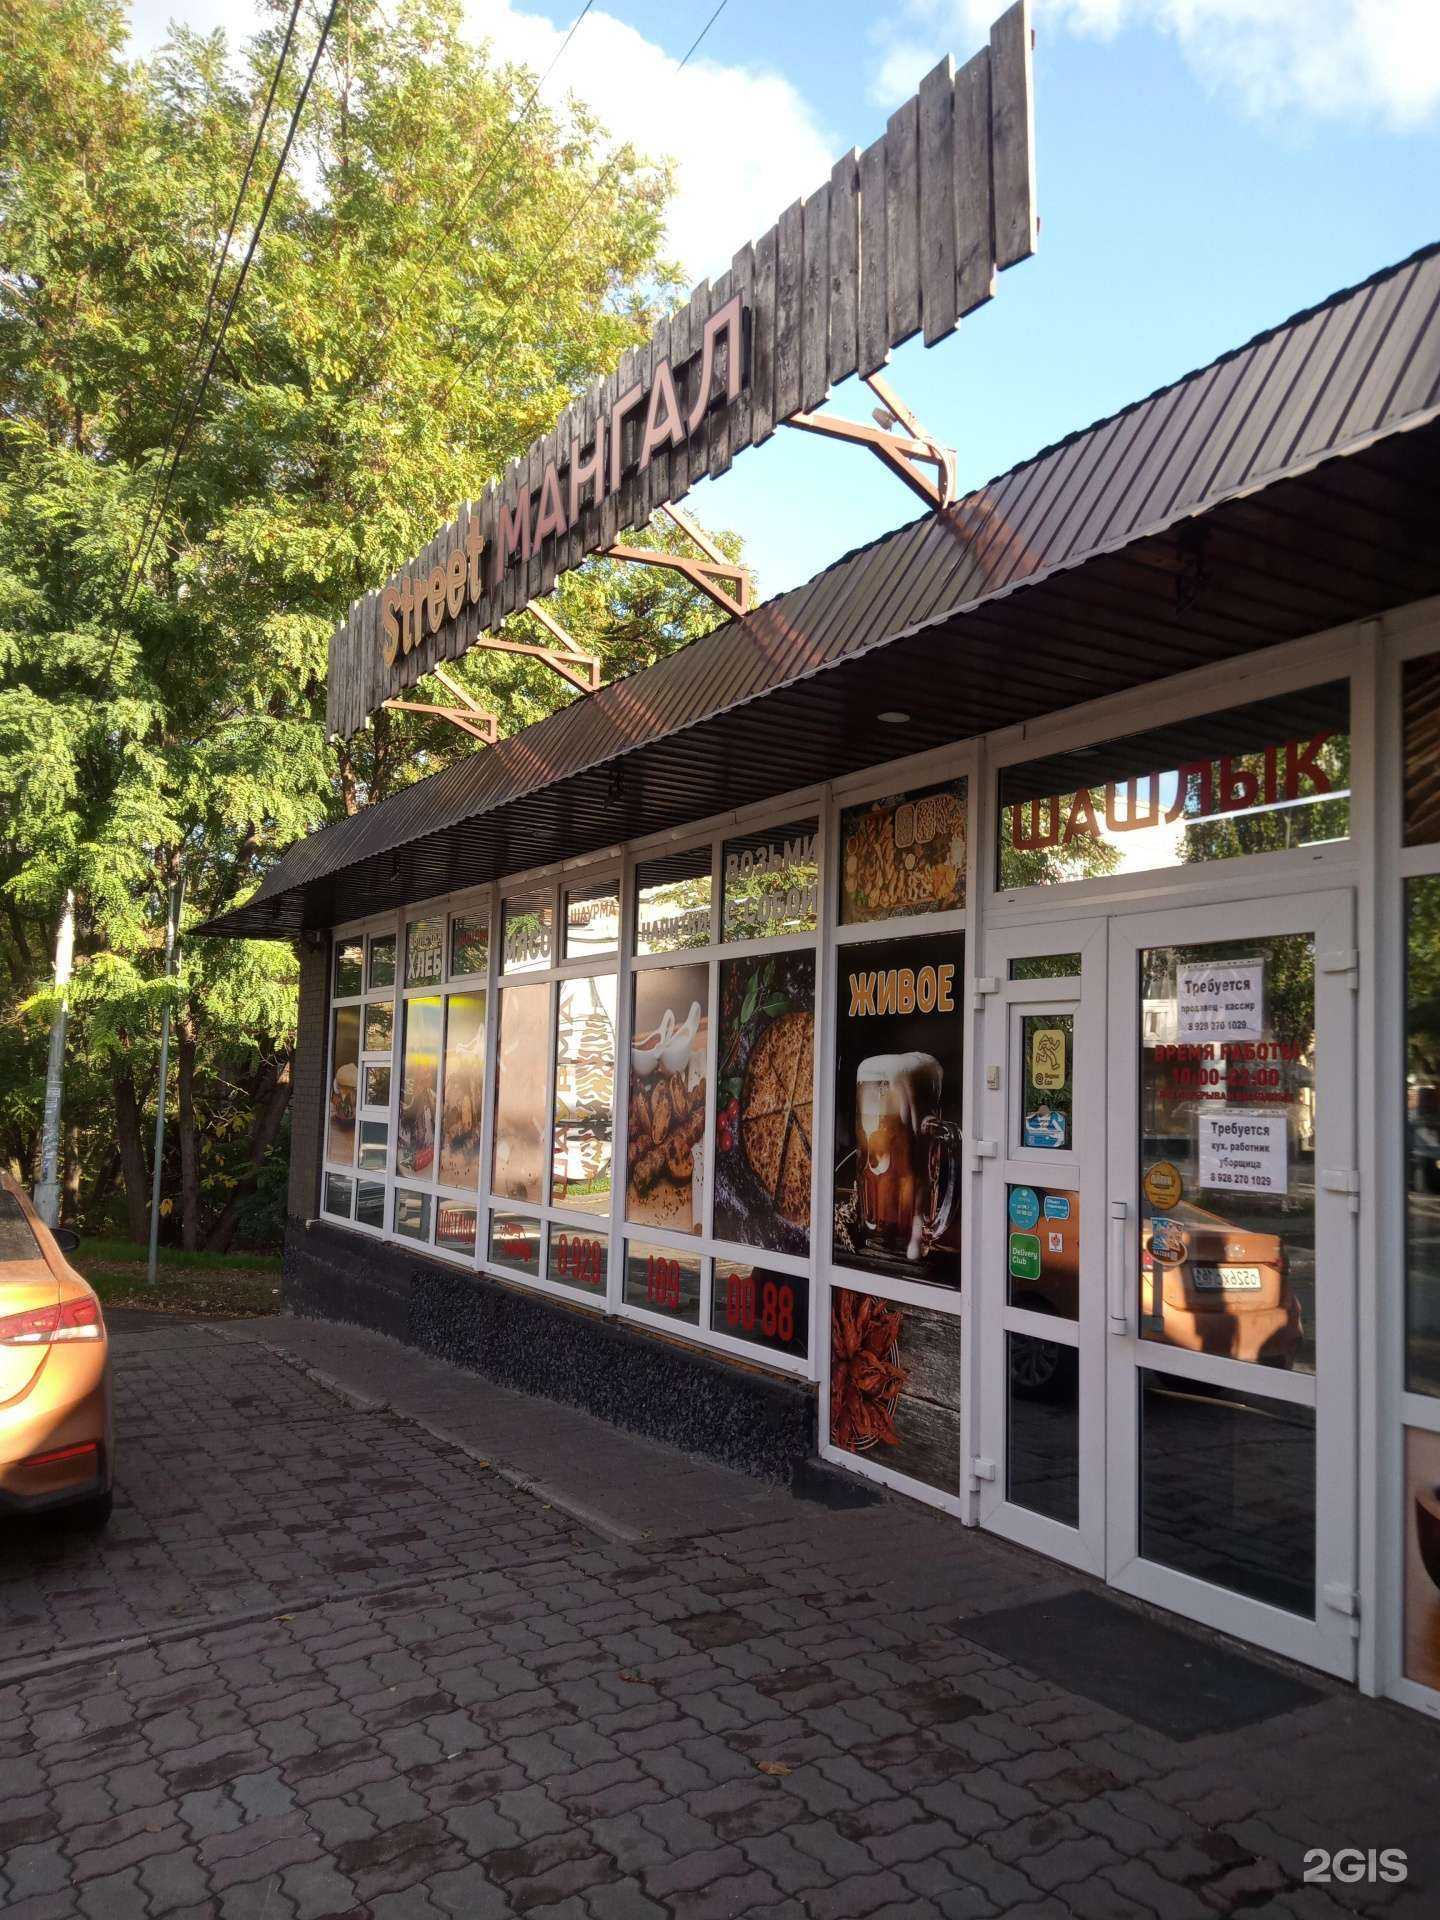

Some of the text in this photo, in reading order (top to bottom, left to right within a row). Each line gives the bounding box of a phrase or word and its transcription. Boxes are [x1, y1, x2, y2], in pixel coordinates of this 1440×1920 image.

[499, 292, 745, 562] МАНГАЛ
[381, 516, 484, 668] Street
[1012, 730, 1340, 852] ШАШЛЫК
[726, 834, 818, 882] ВОЗЬМИ
[569, 901, 619, 924] ШАУРМА
[746, 880, 818, 923] СОБОЙ
[503, 926, 551, 964] МЯСО
[407, 948, 442, 979] ХЛЕБ
[848, 963, 955, 1017] ЖИВОЕ
[1184, 978, 1251, 996] Требуется
[1225, 1002, 1256, 1013] кассир
[1227, 1020, 1247, 1030] 1029
[1154, 1040, 1301, 1063] ВРЕМЯ РАБОТЫ
[1211, 1122, 1270, 1138] Требуется
[1211, 1142, 1271, 1153] кух. работник
[1219, 1157, 1262, 1170] уборщица
[1210, 1172, 1272, 1187] 8 928 270 1029
[1012, 1247, 1038, 1260] Delivery
[1012, 1257, 1027, 1265] Club
[760, 1280, 794, 1342] 88
